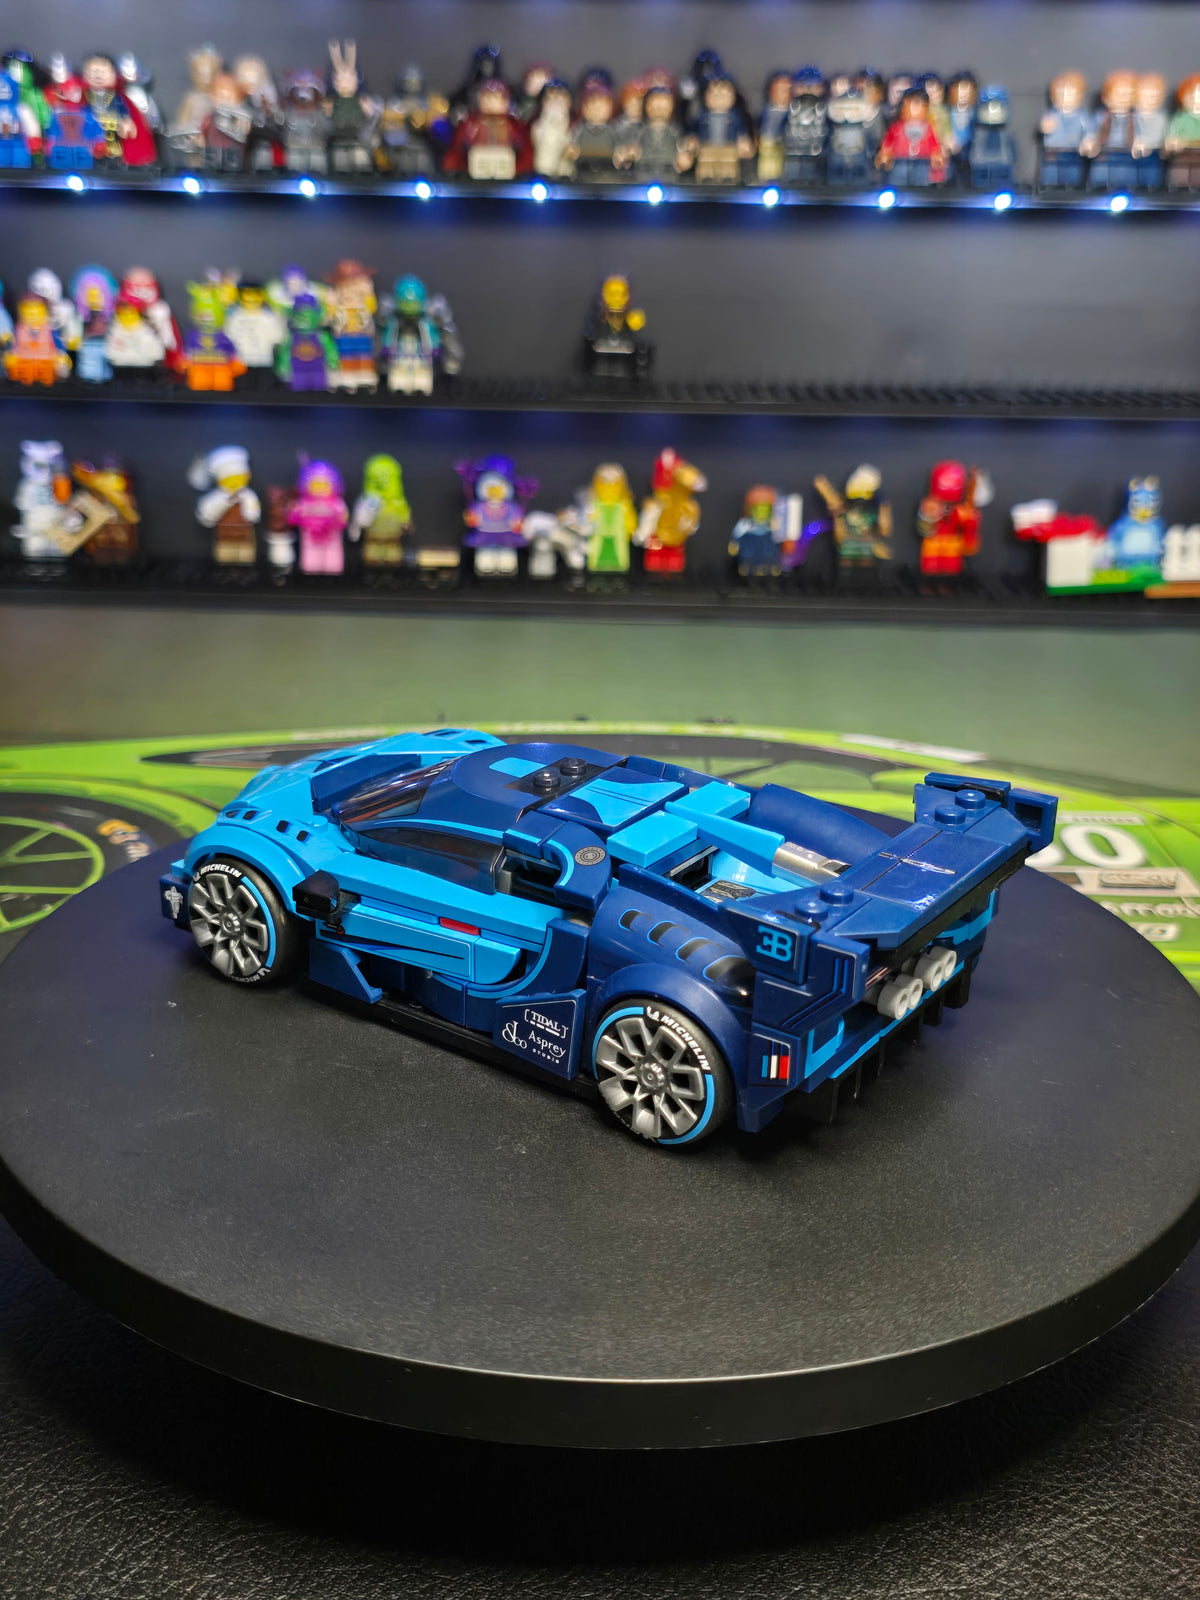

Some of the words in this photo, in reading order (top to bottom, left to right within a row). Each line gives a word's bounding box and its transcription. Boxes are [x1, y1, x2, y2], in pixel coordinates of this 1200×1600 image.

[1024, 824, 1146, 868] 0
[200, 863, 242, 878] MICHELIN
[528, 1030, 567, 1058] Asprey
[661, 1015, 711, 1070] MICHELIN
